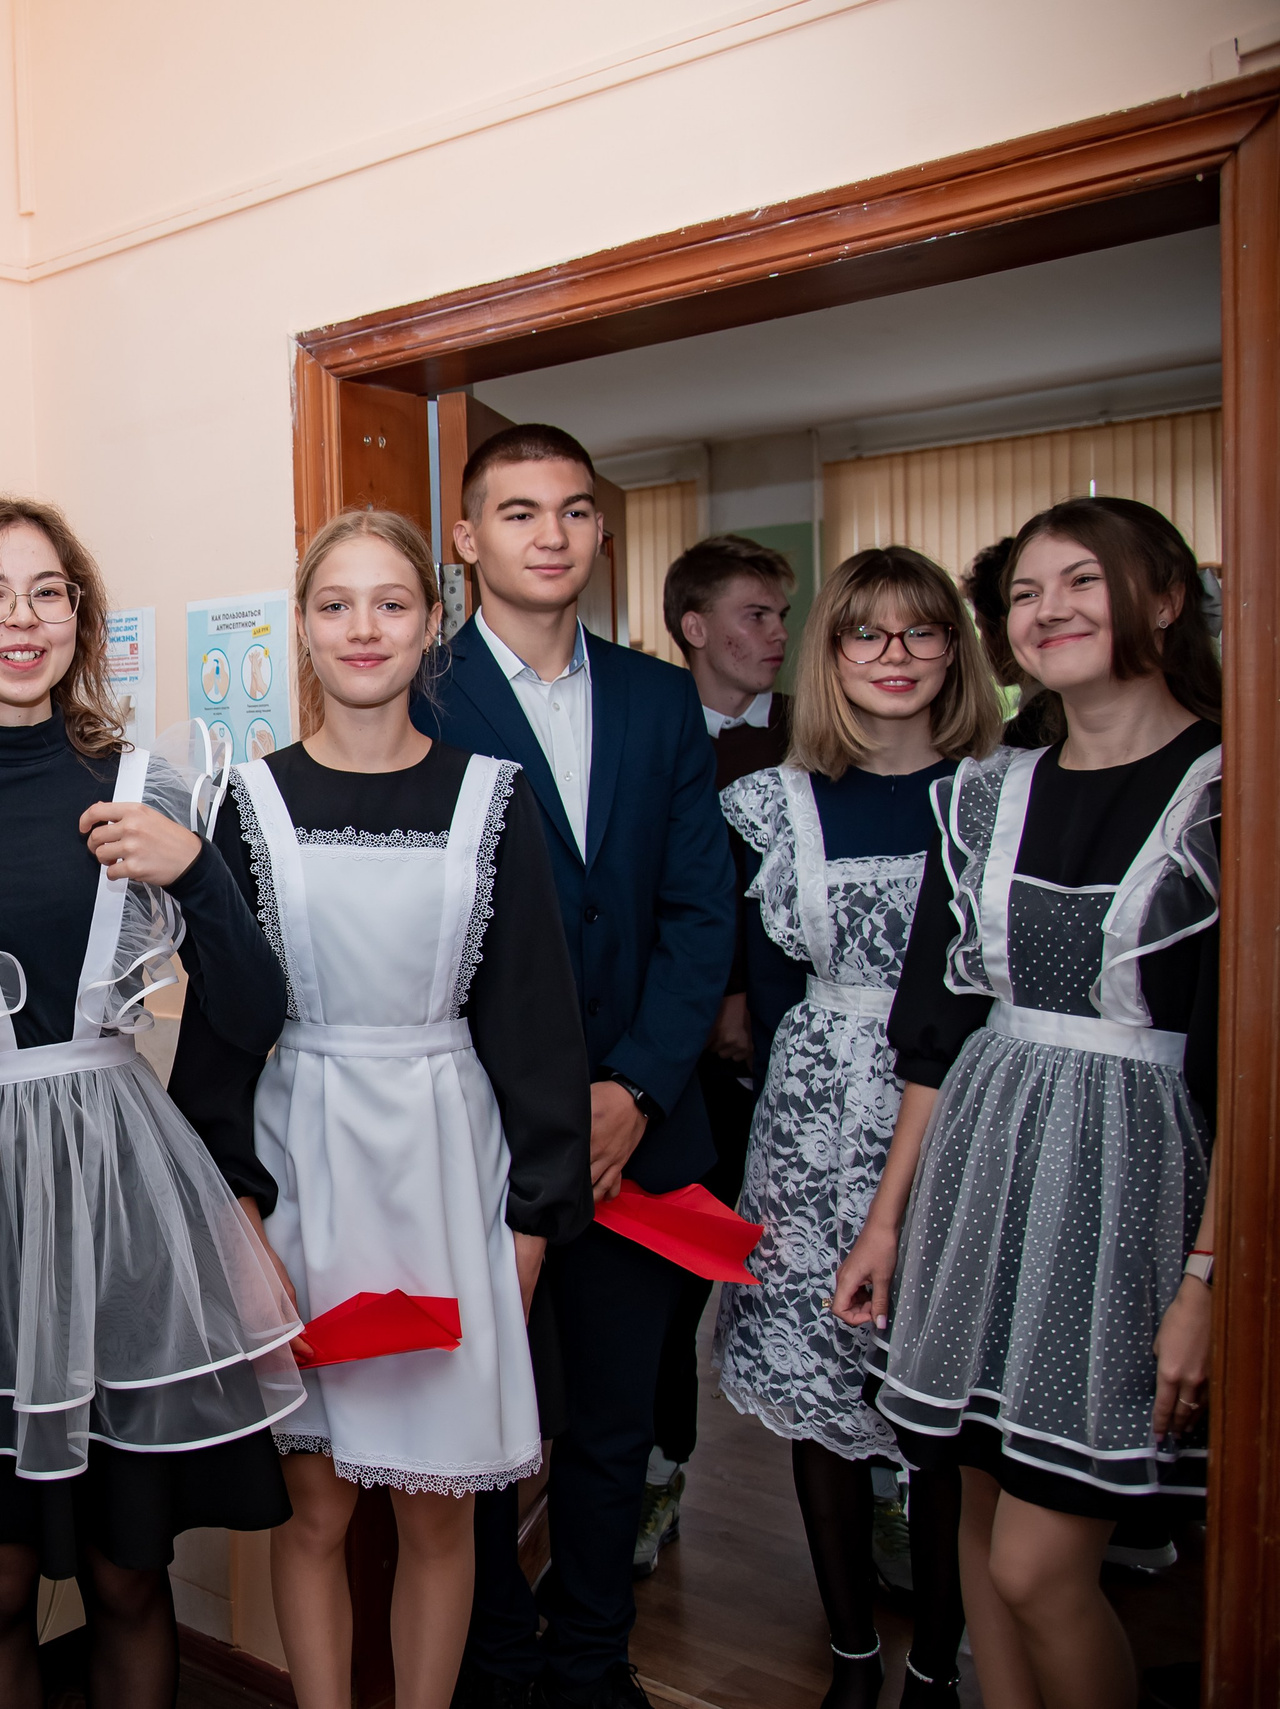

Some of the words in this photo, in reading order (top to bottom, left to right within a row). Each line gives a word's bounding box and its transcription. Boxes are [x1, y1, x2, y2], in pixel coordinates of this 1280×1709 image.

[211, 614, 221, 622] КАК
[221, 609, 262, 620] ПОЛЬЗОВАТЬСЯ
[216, 620, 256, 631] АНТИСЕПТИКОМ
